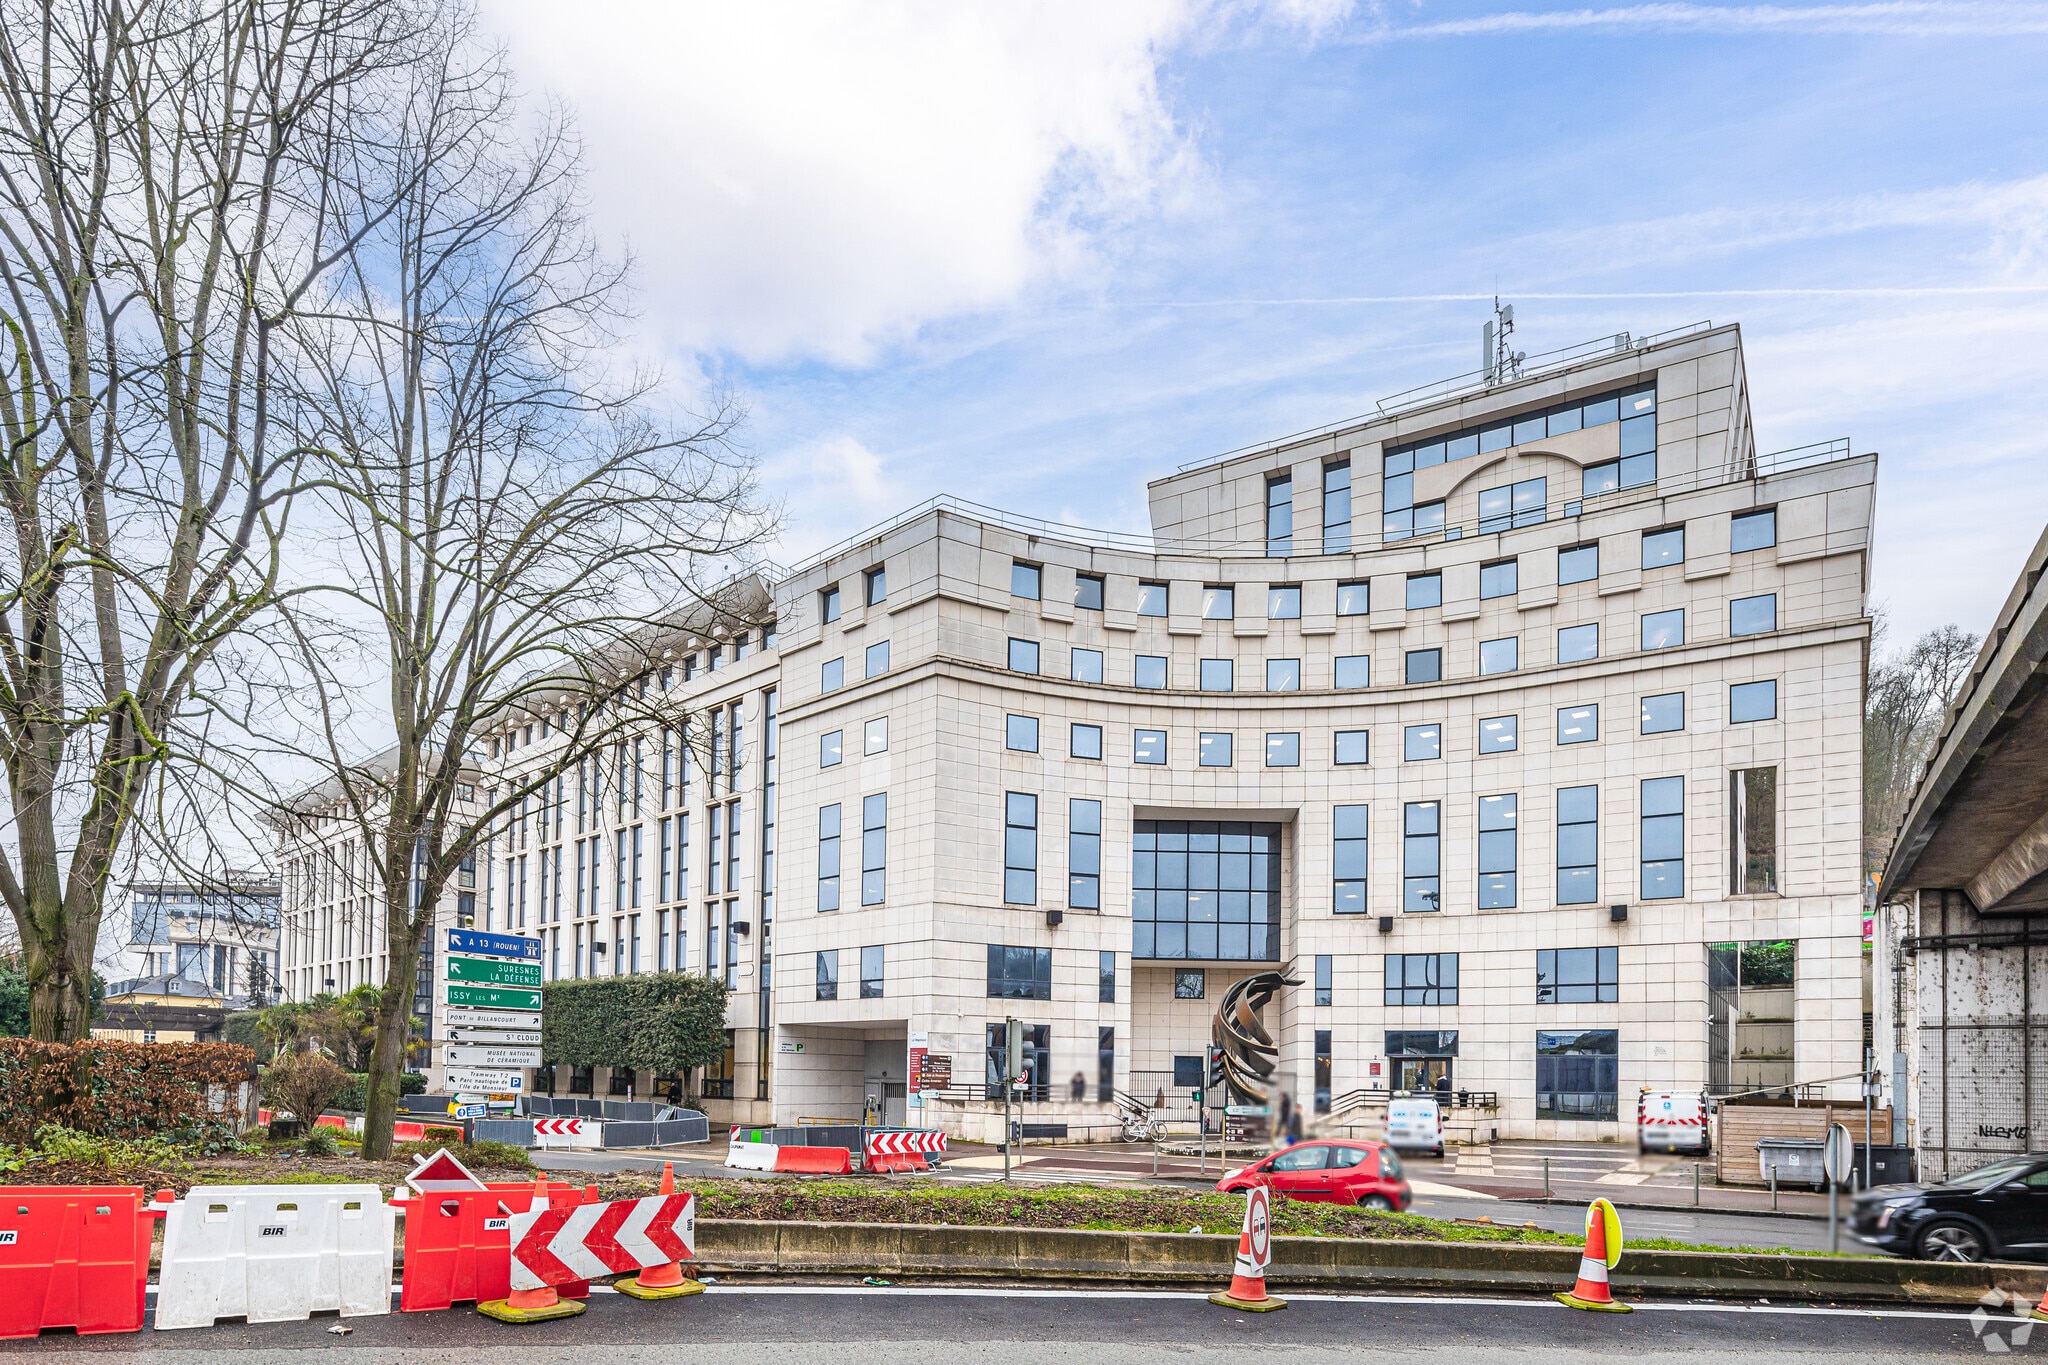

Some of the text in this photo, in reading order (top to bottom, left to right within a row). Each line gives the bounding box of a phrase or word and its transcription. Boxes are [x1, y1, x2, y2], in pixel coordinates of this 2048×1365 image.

[493, 942, 520, 951] (ROUEN)
[498, 965, 539, 975] SURESNES
[505, 974, 539, 984] DÉFENSE
[450, 992, 470, 1000] ISSY
[262, 1227, 284, 1235] BIR
[0, 1233, 15, 1241] IR
